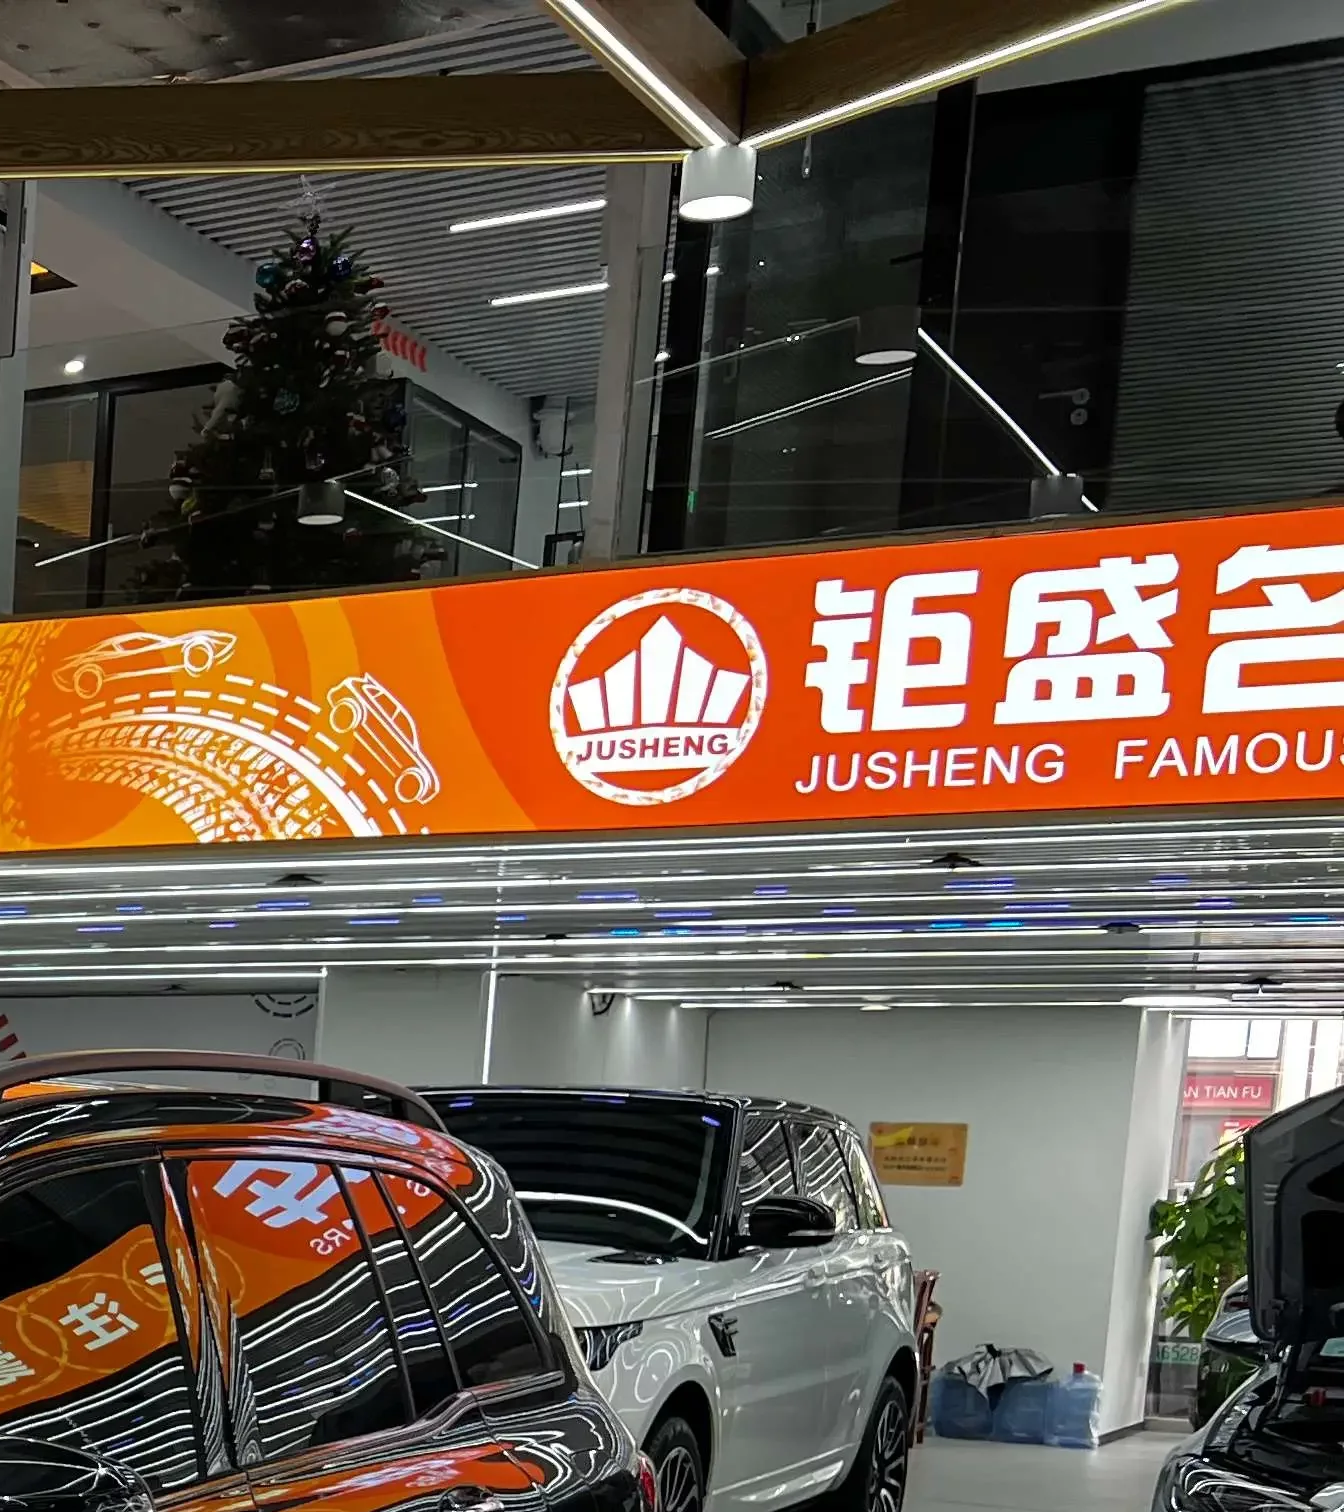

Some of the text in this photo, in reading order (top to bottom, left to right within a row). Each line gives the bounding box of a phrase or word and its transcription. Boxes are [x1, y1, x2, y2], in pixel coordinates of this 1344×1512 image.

[805, 545, 1344, 735] 钜盛名
[576, 732, 729, 762] JUSHENG
[795, 728, 1344, 793] JUSHENG FAMOU
[1204, 1086, 1238, 1099] TIAN
[1242, 1085, 1262, 1099] FU
